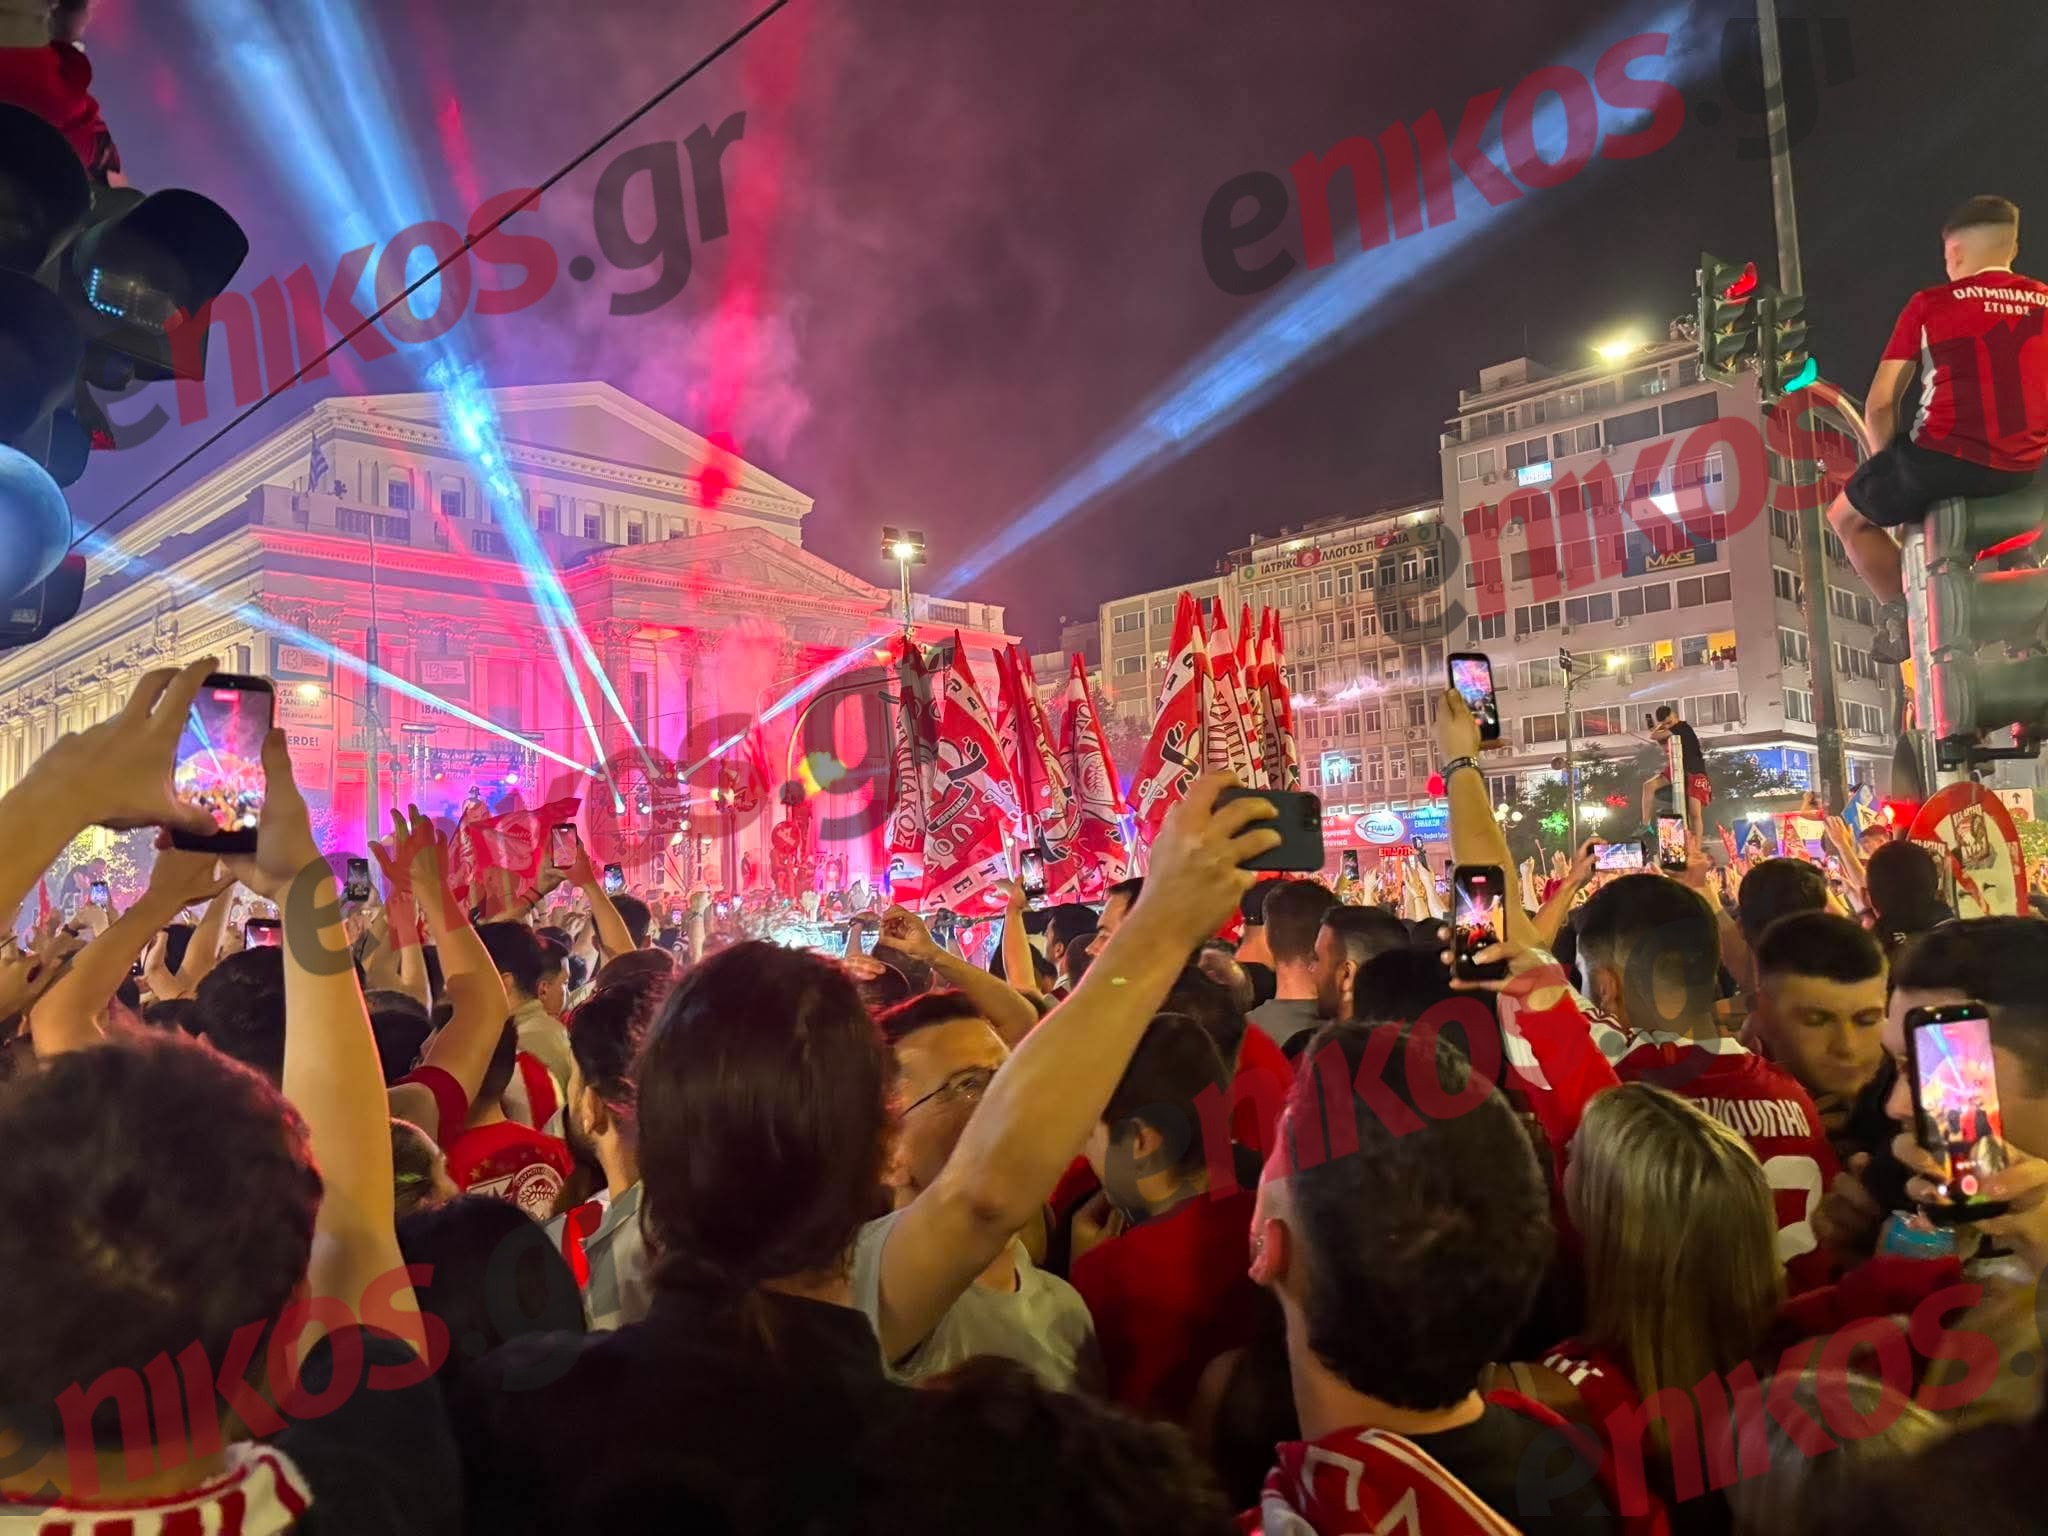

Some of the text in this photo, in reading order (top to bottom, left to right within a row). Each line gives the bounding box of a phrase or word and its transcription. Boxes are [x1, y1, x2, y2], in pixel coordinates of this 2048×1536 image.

[1983, 301, 2031, 316] ΣΤΙΒΟΣ
[1260, 556, 1298, 575] ΙΑΤΡΙΚΟ
[1321, 542, 1364, 561] ΛΛΟΓΟΣ
[1645, 547, 1696, 570] MAG
[287, 735, 319, 747] ERDE!
